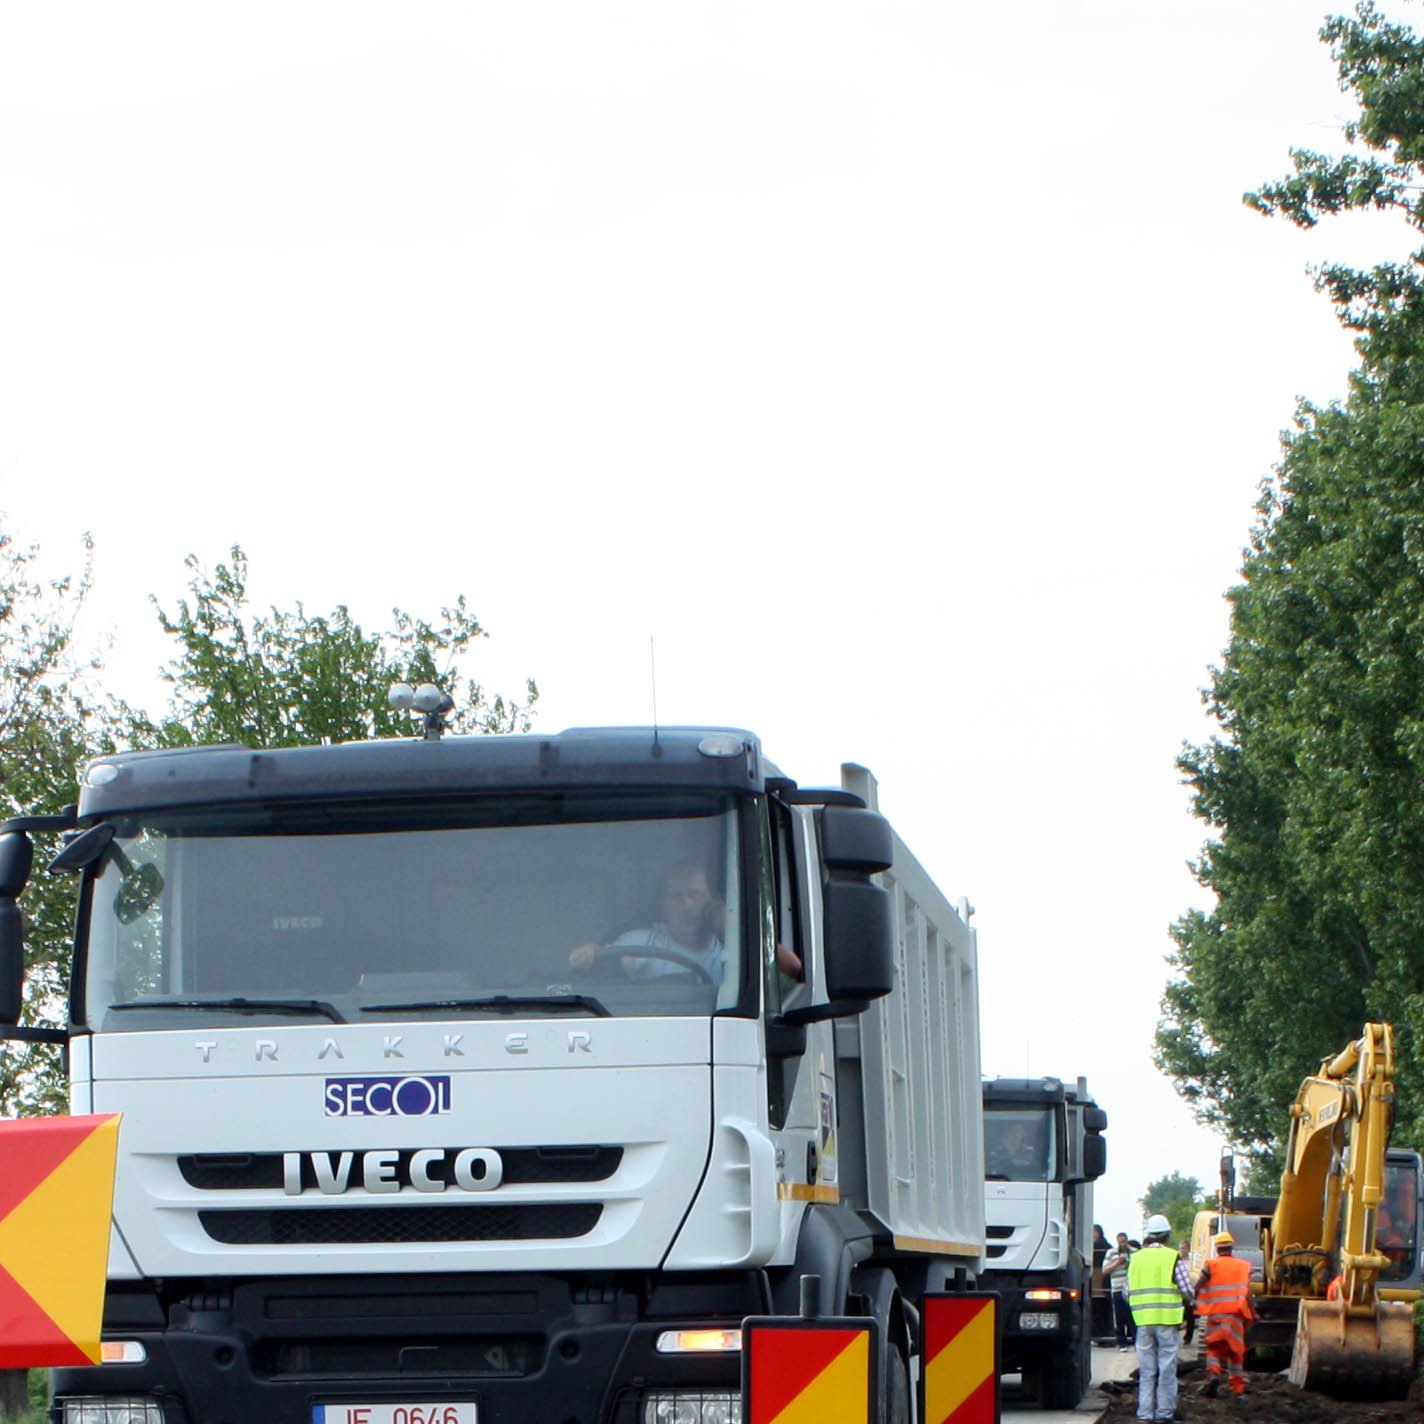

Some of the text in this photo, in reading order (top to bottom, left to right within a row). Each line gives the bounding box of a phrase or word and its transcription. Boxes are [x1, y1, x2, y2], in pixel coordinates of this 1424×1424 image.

[195, 1031, 593, 1063] TRAKKER
[325, 1077, 451, 1117] SECOL
[283, 1147, 503, 1196] IVECO
